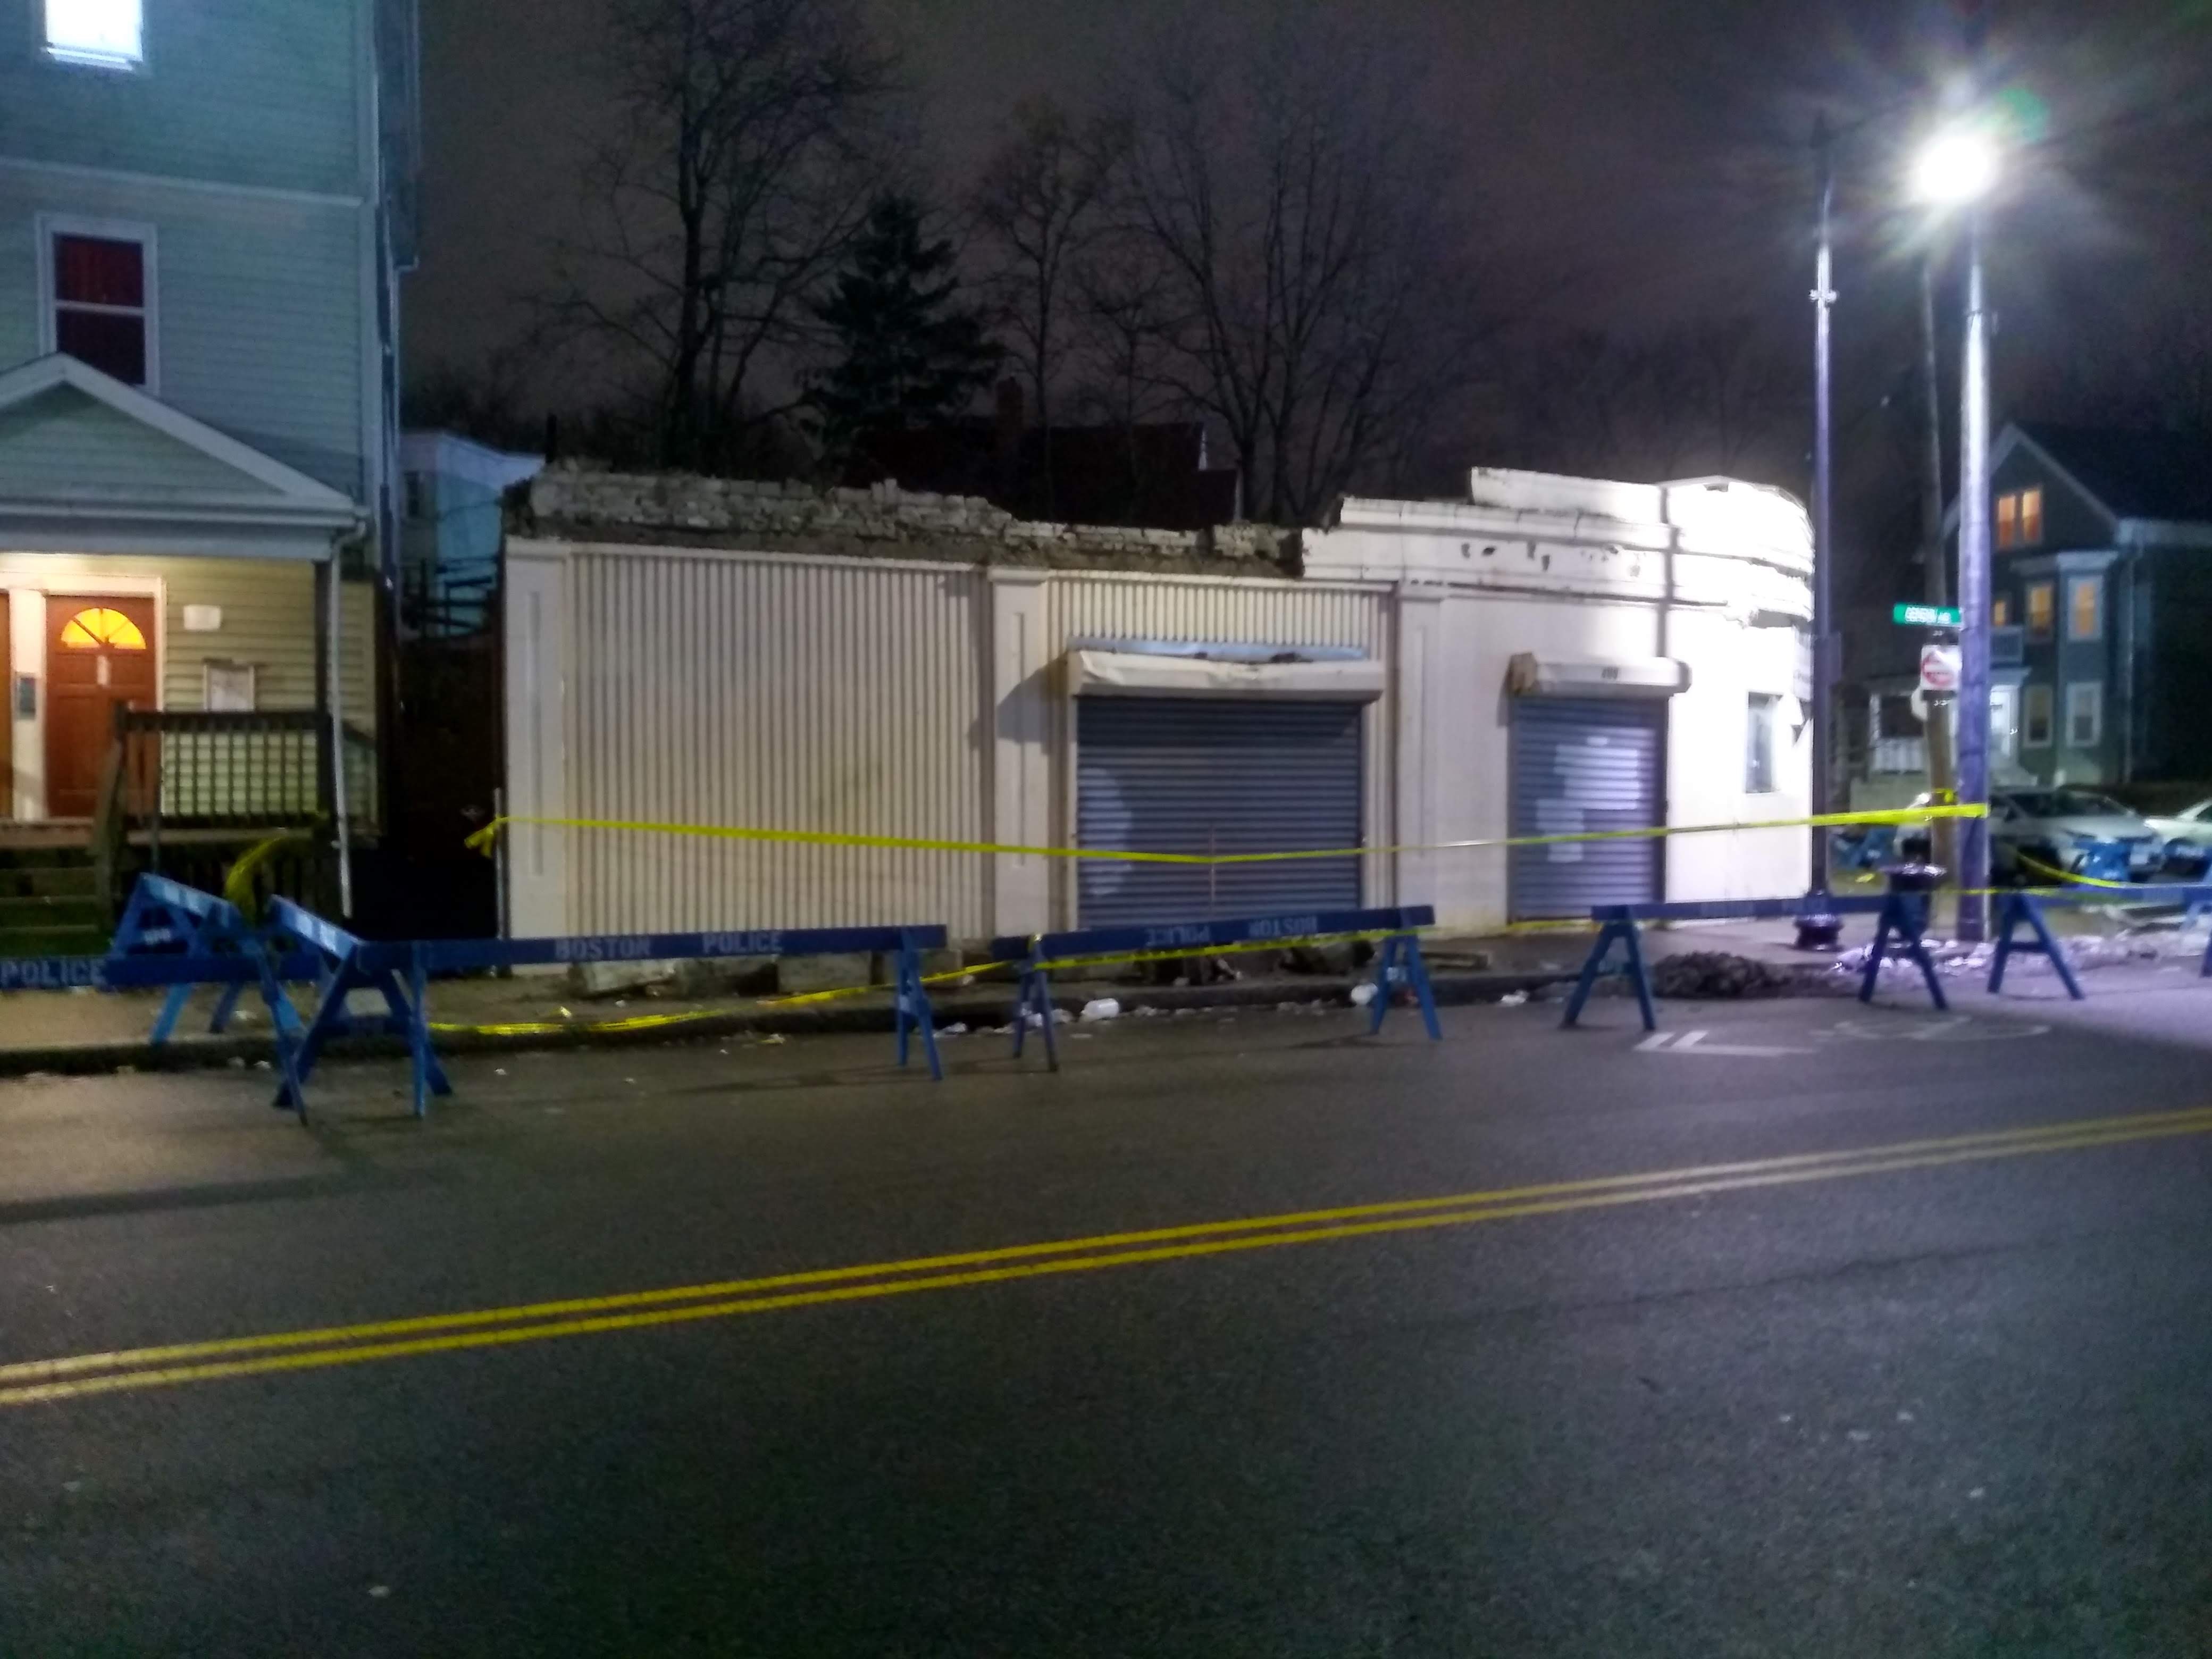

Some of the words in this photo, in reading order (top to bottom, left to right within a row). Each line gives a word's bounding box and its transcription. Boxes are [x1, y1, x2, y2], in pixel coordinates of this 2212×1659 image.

[555, 938, 651, 960] BOSTON
[702, 932, 783, 953] POLICE
[1, 959, 108, 985] POLICE
